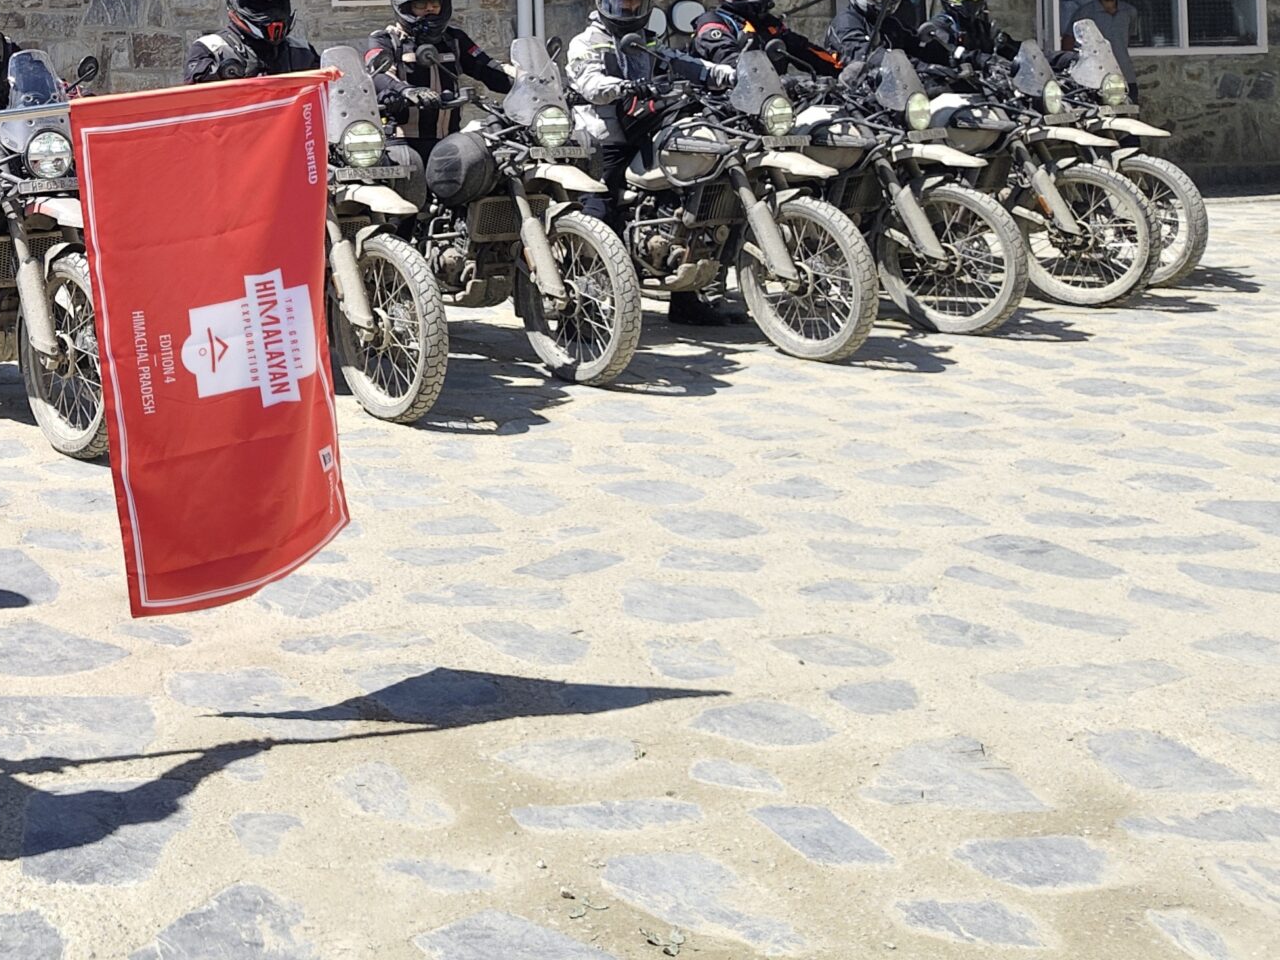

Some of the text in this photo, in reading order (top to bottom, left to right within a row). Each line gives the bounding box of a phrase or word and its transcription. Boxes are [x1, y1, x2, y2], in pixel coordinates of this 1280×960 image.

[302, 102, 318, 185] ROYAL ENFIELD
[131, 310, 156, 415] HIMACHAL PRADESH
[159, 334, 175, 376] EDITION
[240, 303, 260, 382] EXPLORATION
[254, 279, 291, 395] HIMALAYAN
[284, 298, 303, 371] THE GREAT
